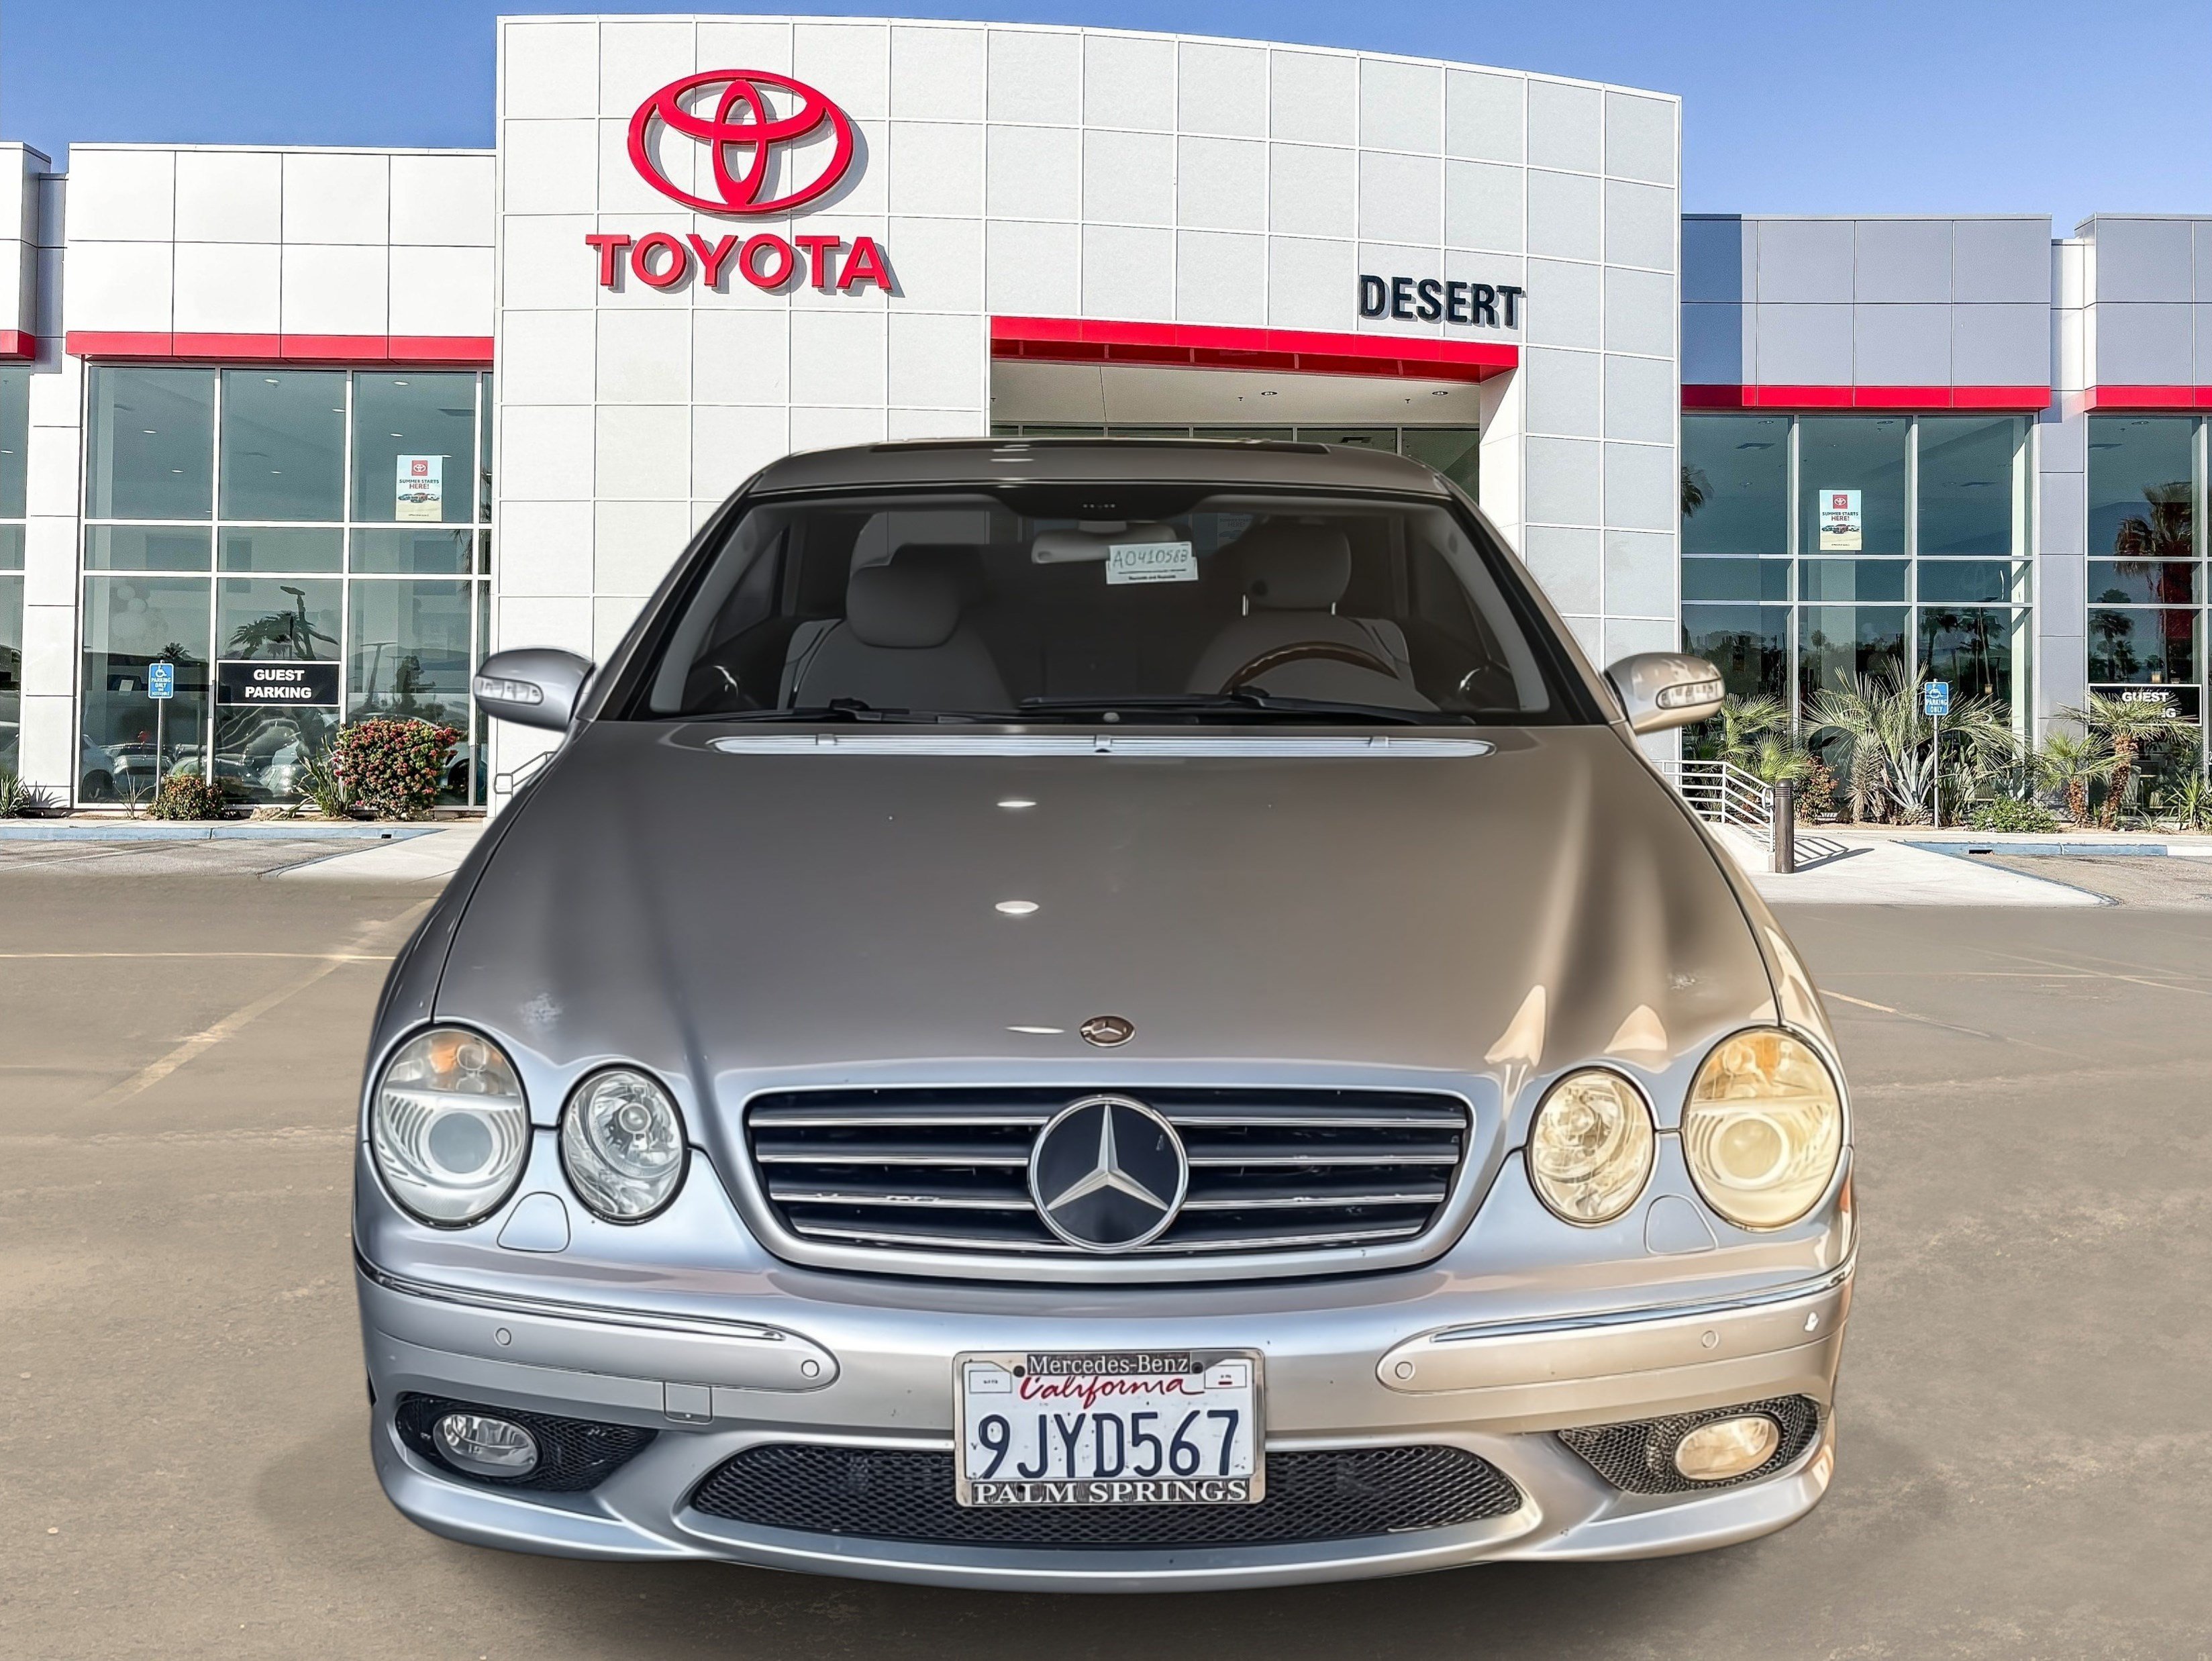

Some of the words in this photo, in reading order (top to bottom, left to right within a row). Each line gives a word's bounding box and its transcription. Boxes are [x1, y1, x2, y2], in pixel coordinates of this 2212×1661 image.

[585, 232, 893, 290] TOYOTA
[1358, 274, 1523, 326] DESERT
[253, 668, 305, 681] GUEST
[245, 686, 312, 699] PARKING
[2121, 691, 2169, 703] GUEST
[1029, 1353, 1189, 1374] Mercedes-Benz
[1019, 1374, 1205, 1409] California
[978, 1409, 1240, 1480] 9JYD567
[974, 1482, 1077, 1505] PALM
[1088, 1479, 1248, 1503] SPRINGS
